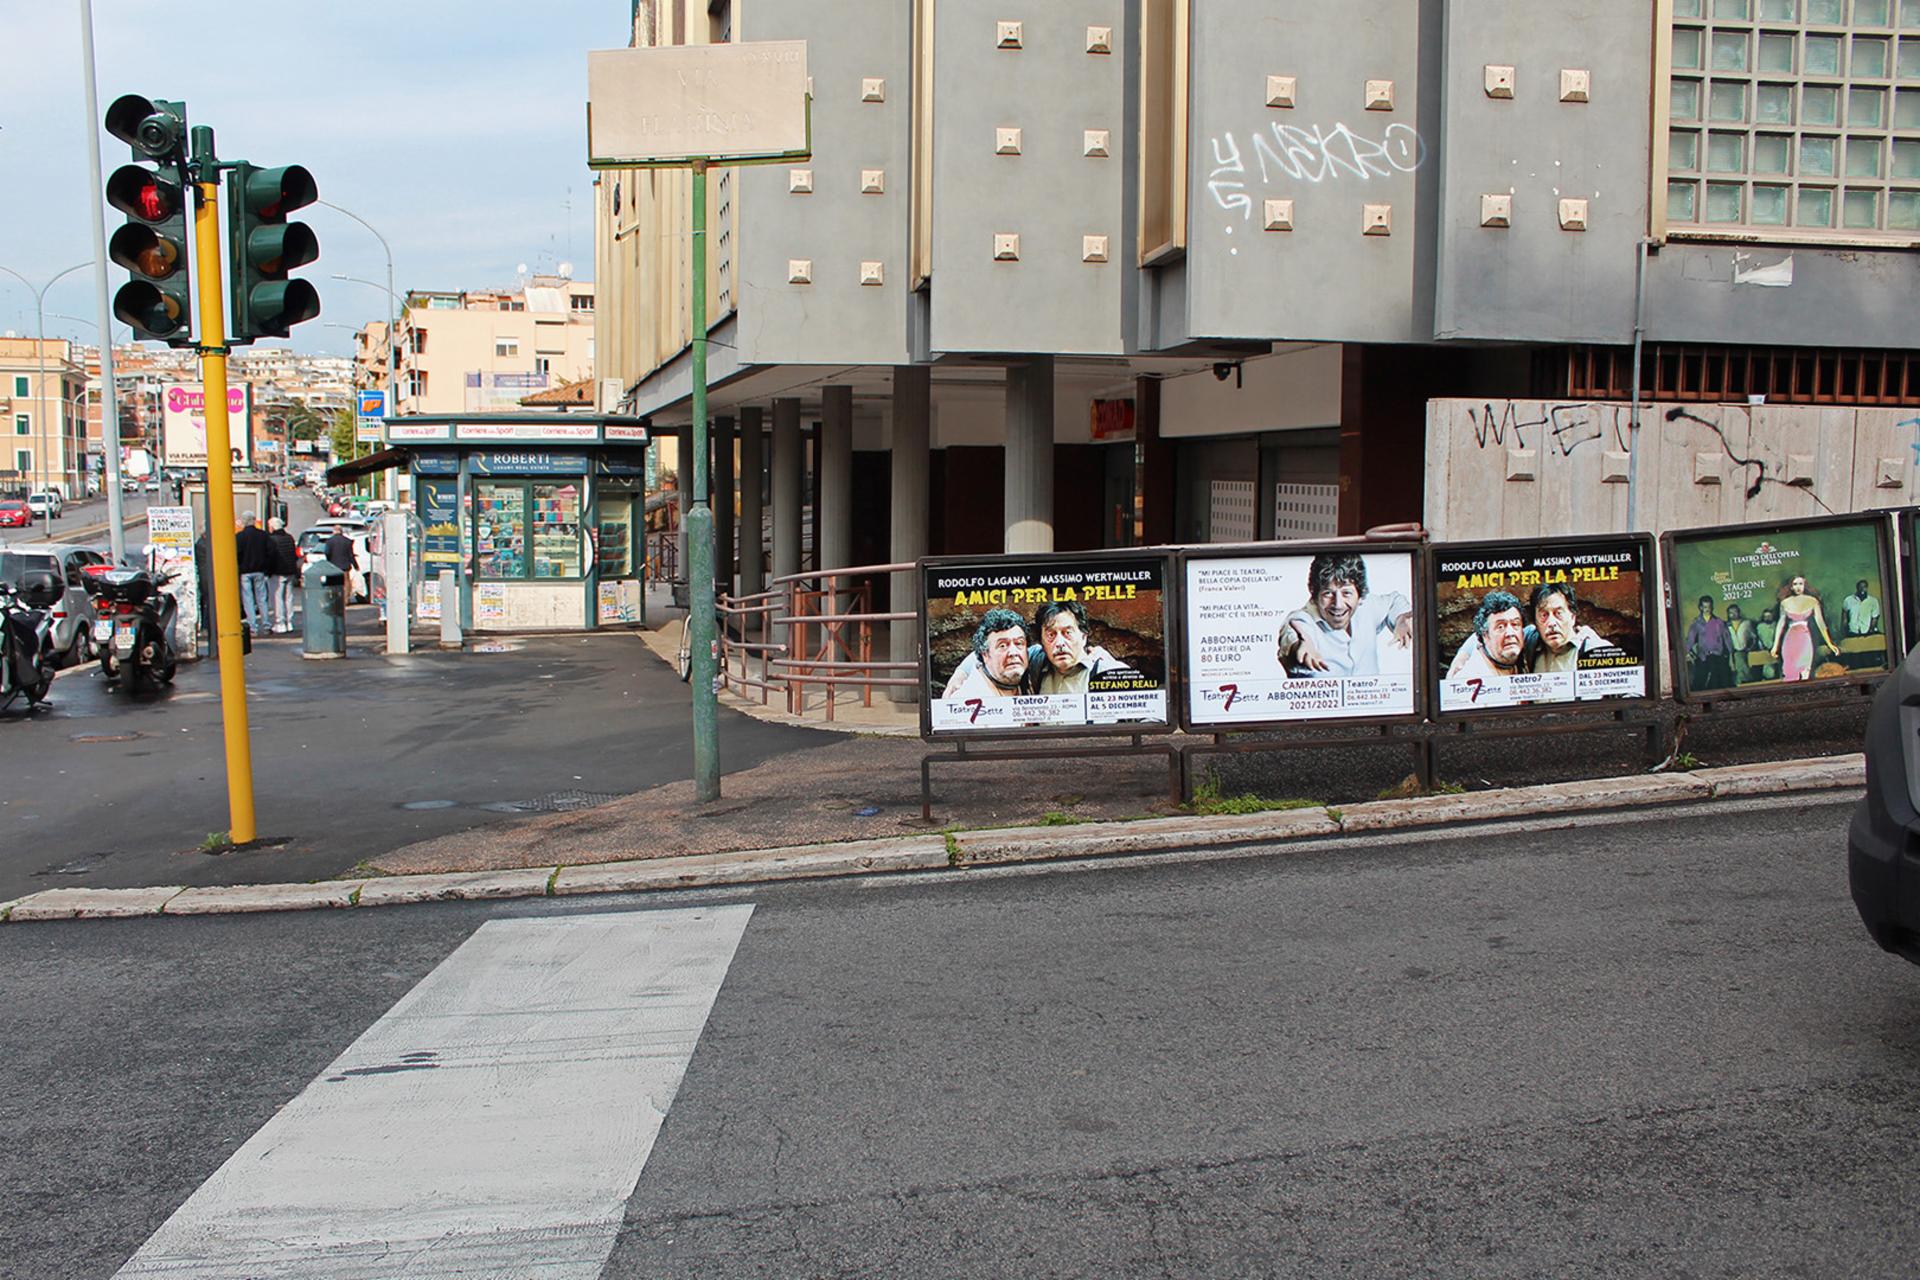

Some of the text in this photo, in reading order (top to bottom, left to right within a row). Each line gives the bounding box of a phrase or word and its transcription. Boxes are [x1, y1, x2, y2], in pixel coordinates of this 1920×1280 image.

[675, 67, 720, 88] VIA
[493, 453, 550, 464] ROBERTI
[1442, 562, 1484, 572] RODOLFO
[1533, 557, 1572, 567] MASSIMO
[1573, 553, 1632, 564] WERTMULLER
[1733, 551, 1800, 563] TEATRO DELL'OPERA
[938, 578, 984, 588] RODOLFO
[1040, 573, 1083, 584] MASSIMO
[1085, 570, 1152, 582] WERTMULLER
[1457, 566, 1619, 589] AMICI PER LA PELLE
[1722, 580, 1766, 592] STAGIONE
[954, 584, 1136, 606] AMICI PER LA PELLE
[1723, 590, 1752, 600] 2021-22
[1200, 634, 1272, 644] ABBONAMENTI
[1201, 654, 1242, 662] 80 EURO
[1578, 656, 1638, 668] STEFANO REALI
[1347, 679, 1378, 688] Teatro7
[1510, 675, 1542, 683] Teatro7
[1090, 680, 1158, 690] STEFANO REALI
[1282, 680, 1338, 690] CAMPAGNA
[1118, 693, 1159, 701] NOVEMBRE
[1219, 684, 1238, 712] 7
[1267, 690, 1338, 700] ABBONAMENTI
[1012, 696, 1049, 706] Teatro7
[1290, 699, 1338, 710] 2021/2022
